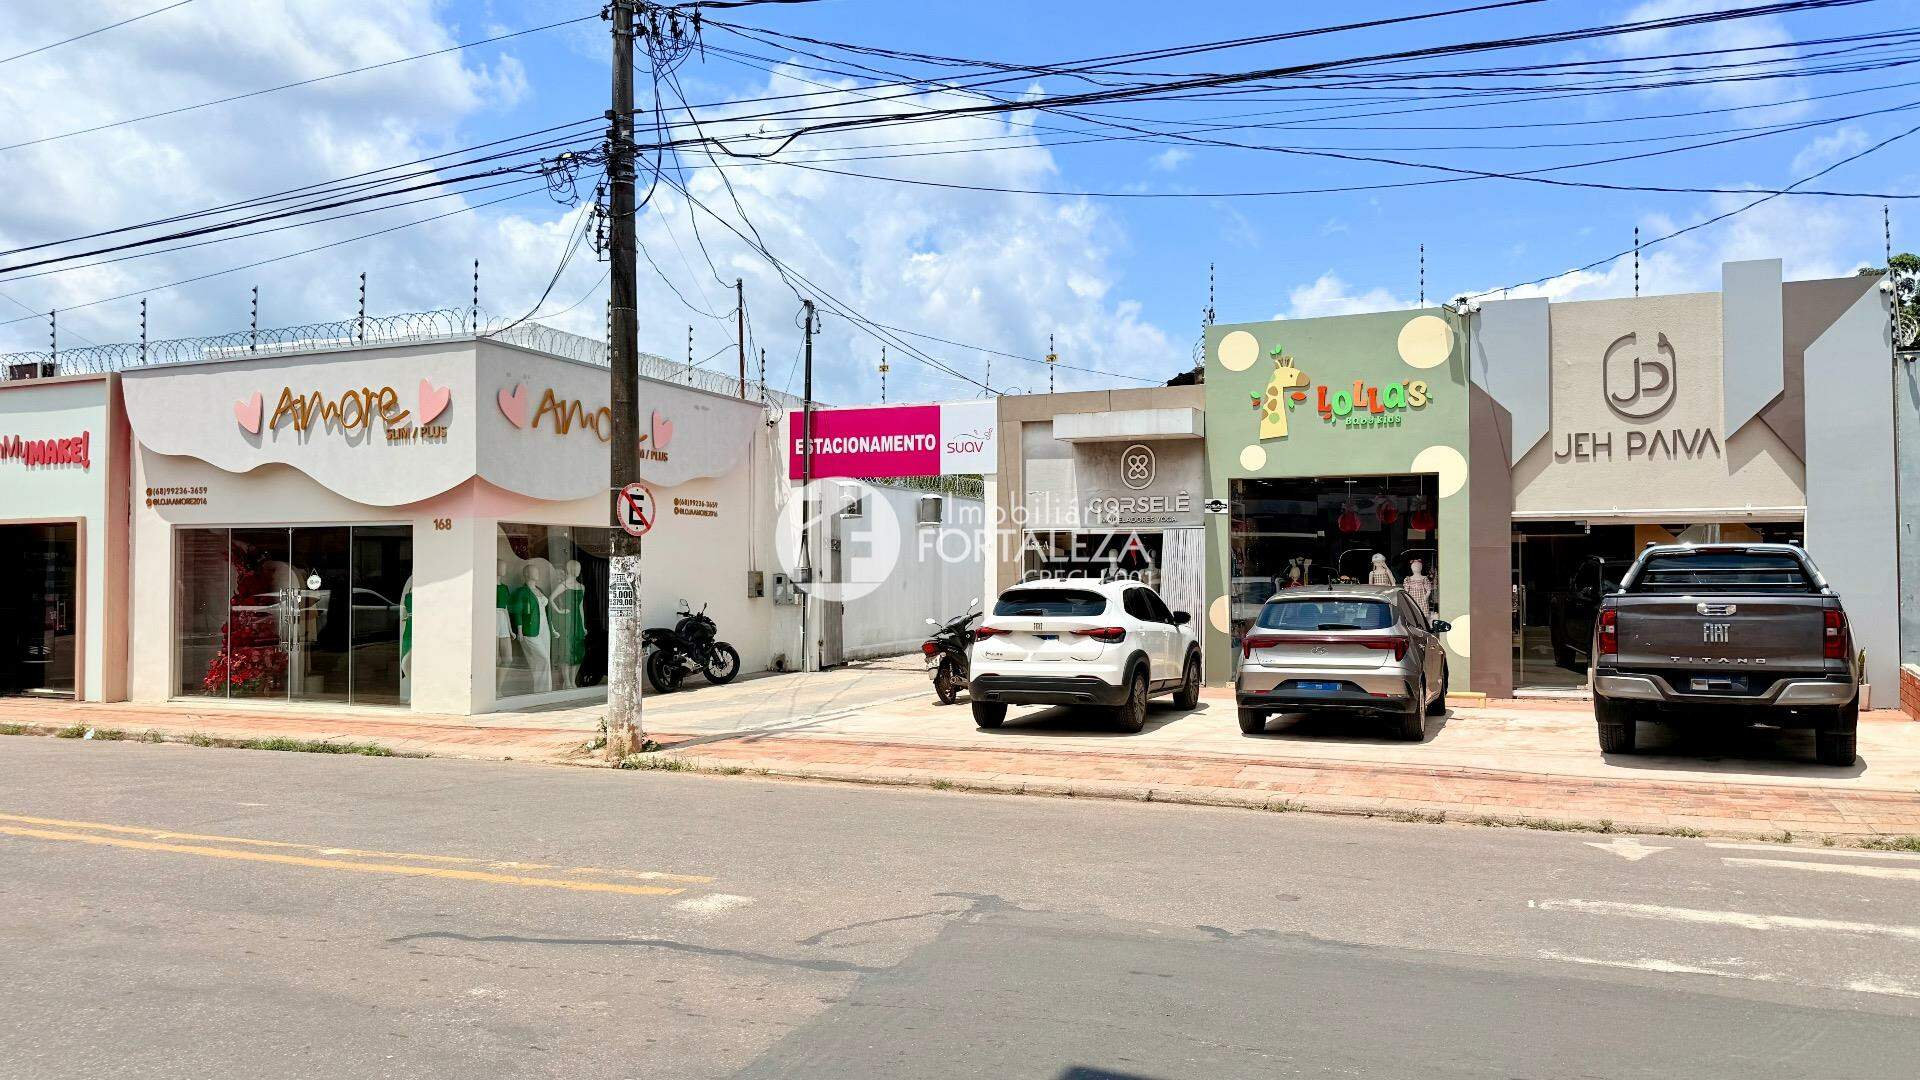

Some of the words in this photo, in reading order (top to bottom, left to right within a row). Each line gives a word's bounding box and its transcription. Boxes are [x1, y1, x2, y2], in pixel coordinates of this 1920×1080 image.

[531, 388, 649, 442] Amo
[386, 429, 410, 441] SLIM
[421, 426, 448, 439] PLUS
[795, 433, 936, 455] ESTACIONAMENTO
[1554, 431, 1611, 457] JEH
[1626, 428, 1720, 456] PAIVA
[651, 451, 668, 462] PLUS
[153, 487, 208, 496] (68)99236-3659
[1089, 490, 1190, 514] CORSELÊ
[433, 518, 452, 531] 168
[1703, 623, 1731, 643] FIAT
[1670, 656, 1766, 664] TITANO
